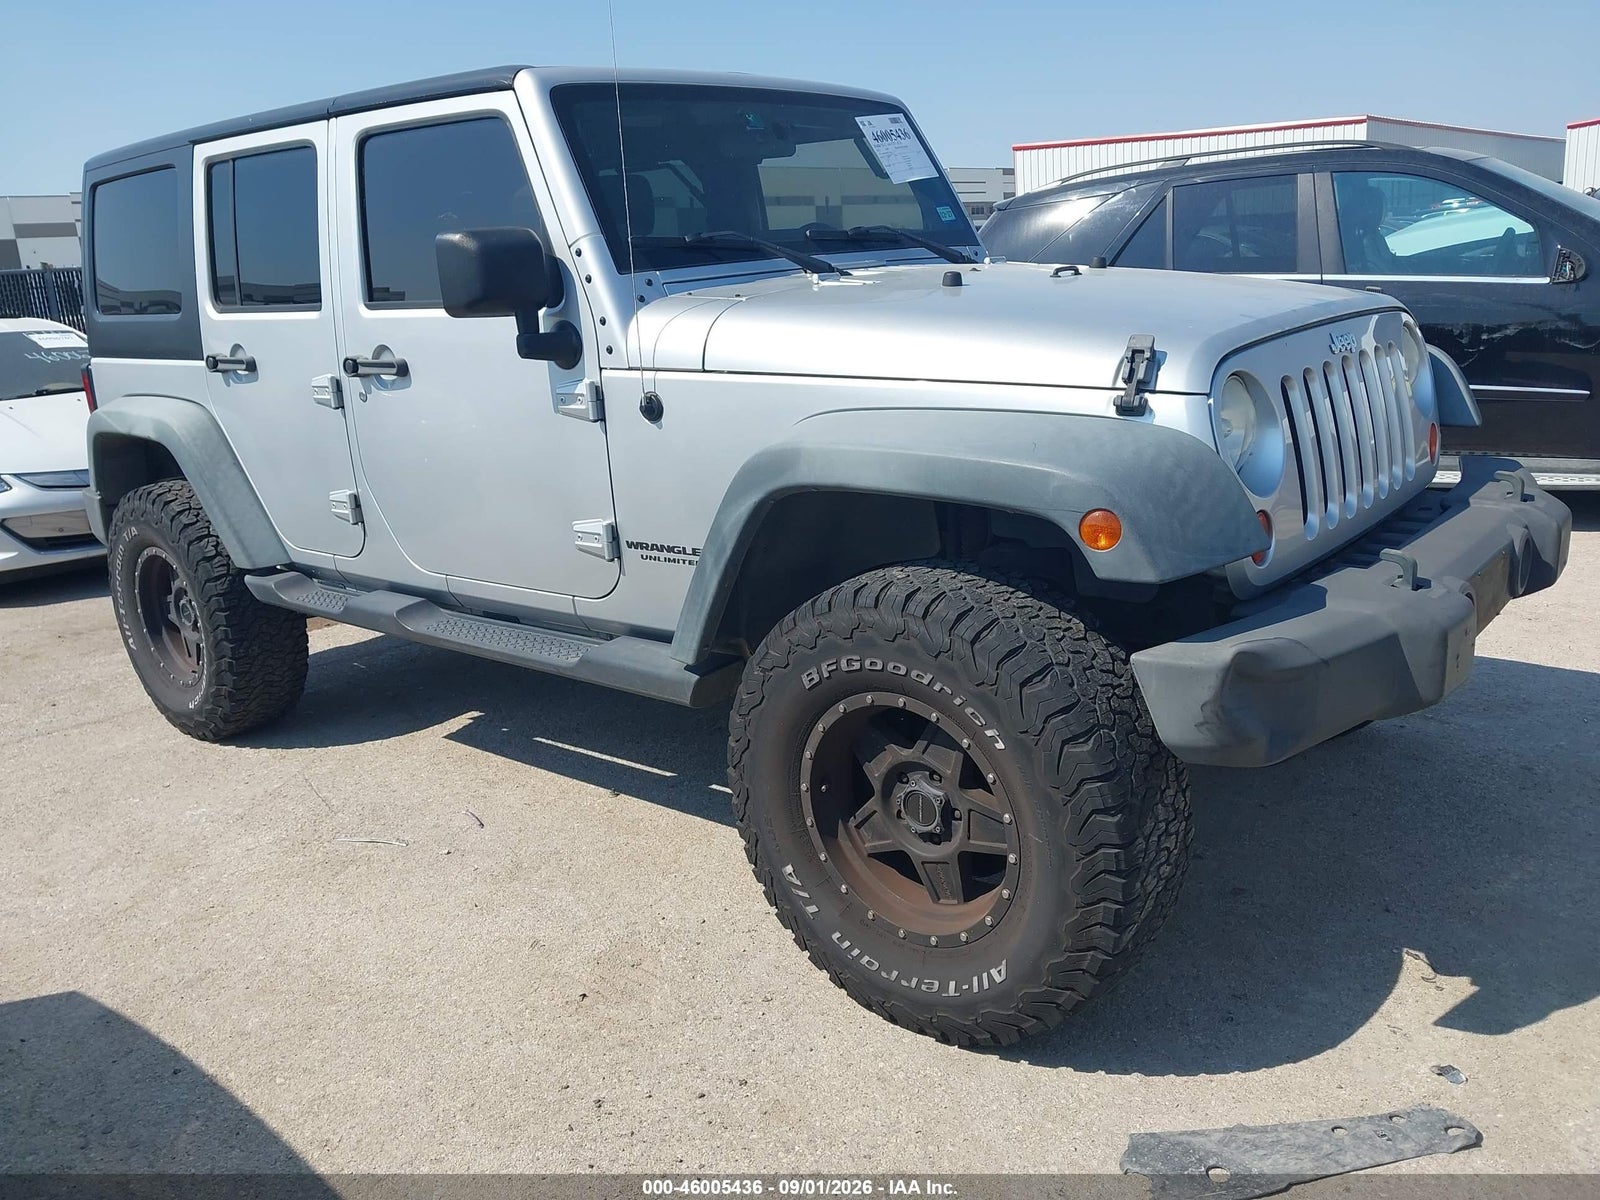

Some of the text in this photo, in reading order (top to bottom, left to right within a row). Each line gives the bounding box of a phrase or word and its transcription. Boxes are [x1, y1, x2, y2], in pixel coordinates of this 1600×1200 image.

[872, 128, 911, 143] 46005436
[1329, 332, 1357, 354] Jeep
[625, 540, 702, 557] WRANGLE
[640, 554, 699, 566] UNLIMITE
[116, 526, 138, 650] All-Terrain T/A
[801, 655, 1006, 750] BFGoodrich
[782, 863, 820, 920] T/A
[832, 931, 1007, 998] All-Terrain
